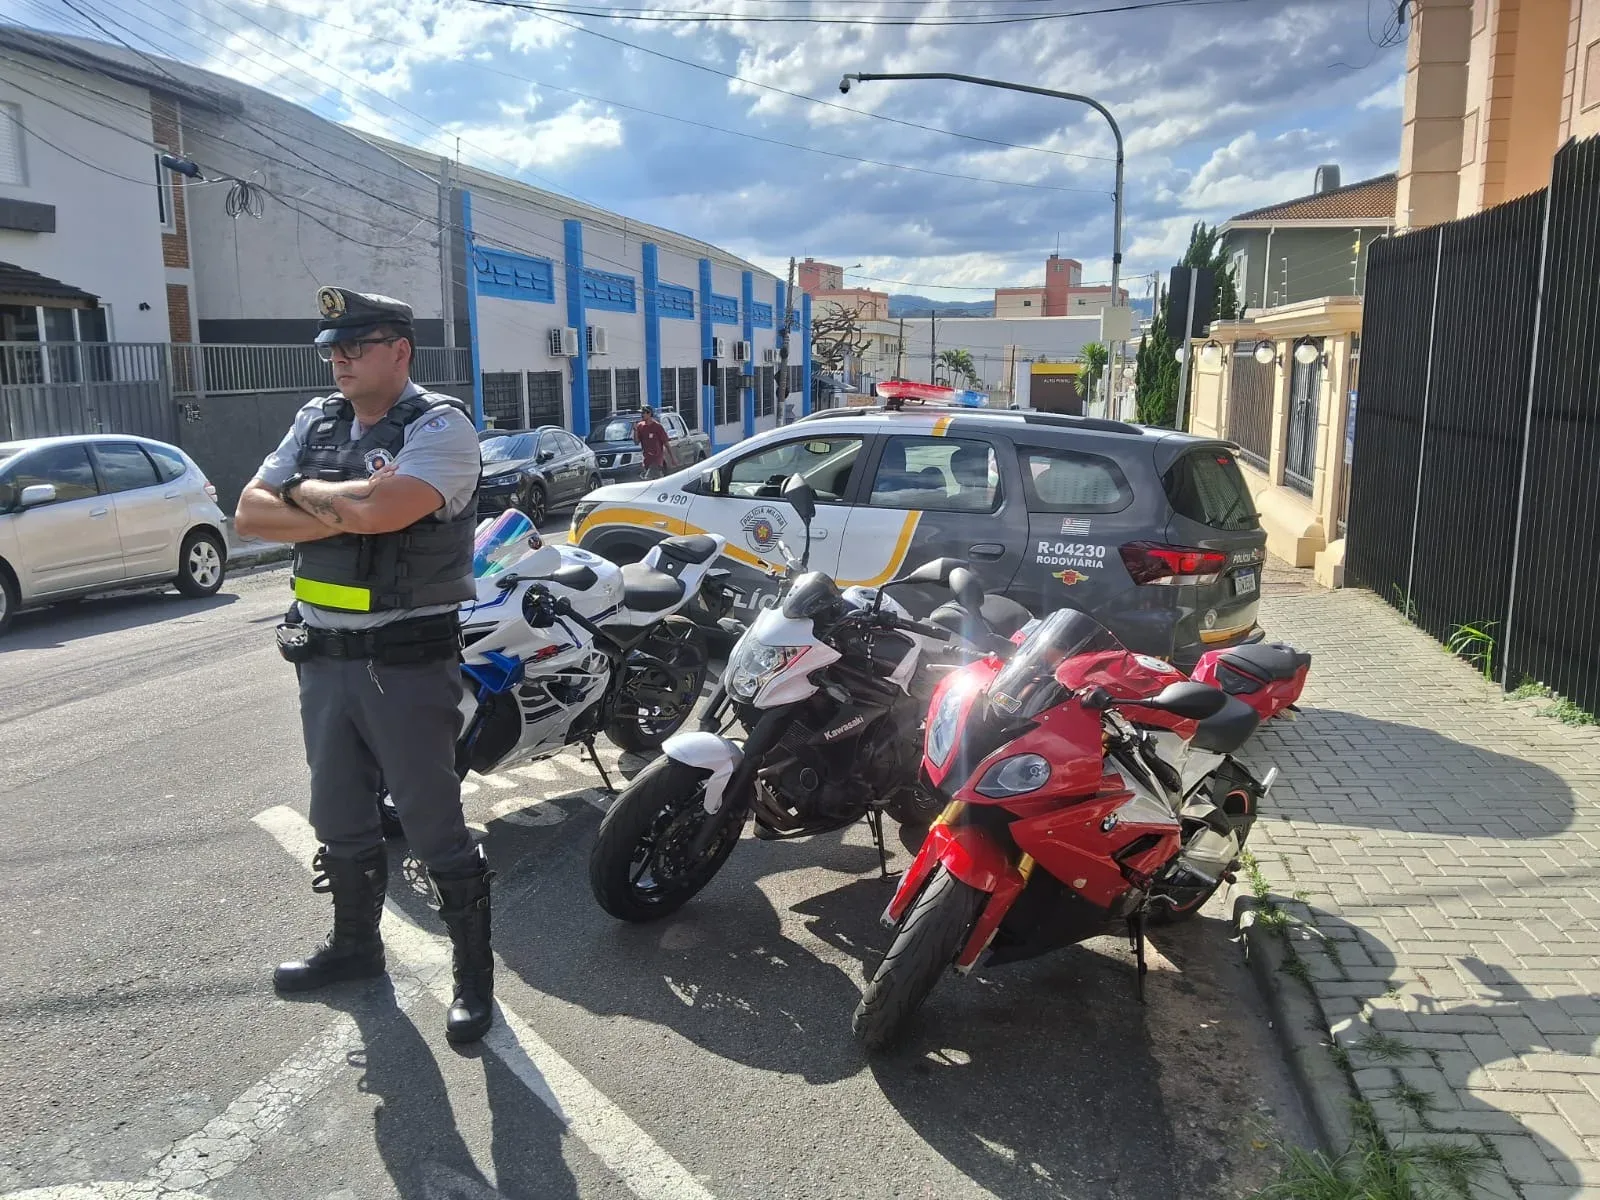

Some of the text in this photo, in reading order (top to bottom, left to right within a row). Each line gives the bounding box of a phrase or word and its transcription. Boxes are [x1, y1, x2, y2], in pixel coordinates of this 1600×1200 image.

[669, 494, 688, 505] 190
[1038, 541, 1106, 558] R-04230
[1036, 555, 1104, 569] RODOVIÁRIA
[823, 714, 864, 741] Kawasaki
